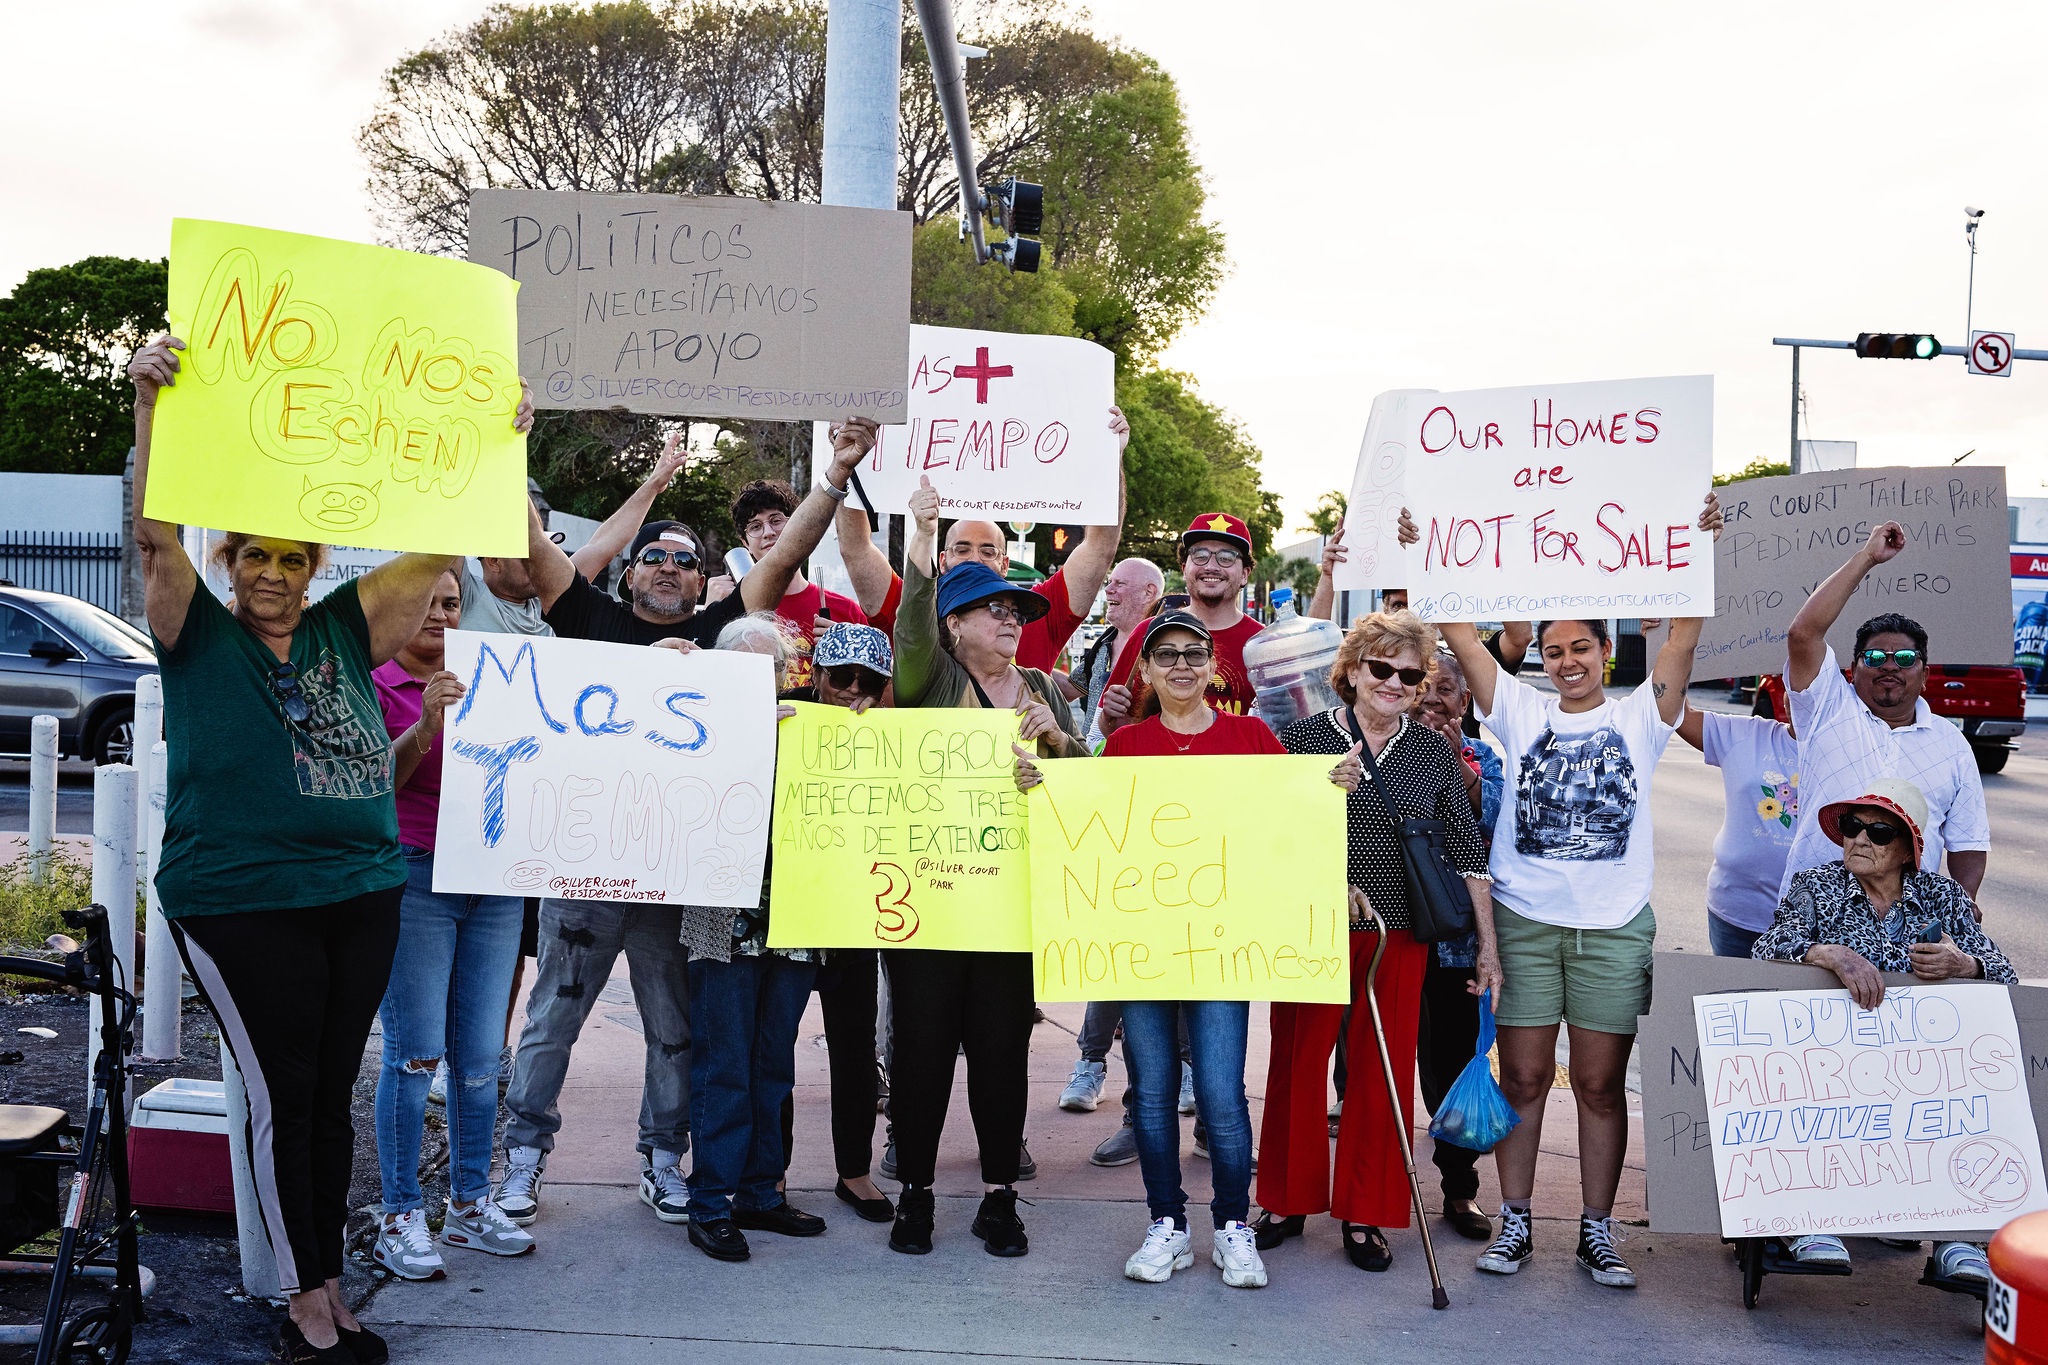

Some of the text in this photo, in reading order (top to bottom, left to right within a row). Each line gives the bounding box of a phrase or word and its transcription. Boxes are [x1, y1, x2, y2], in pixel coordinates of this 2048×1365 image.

[525, 327, 762, 379] TU APOYO
[911, 354, 952, 394] AS
[1420, 398, 1663, 453] OUR HOMES
[1513, 465, 1574, 489] are
[1719, 501, 1752, 523] ER
[1770, 483, 1847, 518] COURT
[1948, 478, 1999, 518] PARK
[1425, 513, 1516, 572] NOT
[1595, 502, 1692, 573] SALE
[1696, 639, 1738, 660] Silver
[2015, 639, 2047, 655] JACK
[454, 640, 713, 755] Mas
[801, 722, 902, 771] URBAN
[450, 735, 765, 897] TIEMPO
[782, 781, 1029, 818] MERECEMOS TRES
[1042, 773, 1200, 853] We
[778, 818, 847, 856] AÑOS
[863, 826, 898, 855] DE
[914, 856, 1000, 878] @SILVER COURT
[929, 878, 954, 891] PARK
[1063, 834, 1228, 920] Need
[869, 861, 920, 943] 3
[1042, 937, 1166, 995] more
[1700, 987, 1961, 1048] EL DUEÑO
[1713, 1034, 2019, 1108] MARQUIS
[1722, 1095, 1990, 1146] NI VIVE EN
[1723, 1141, 1935, 1202] MIAMI
